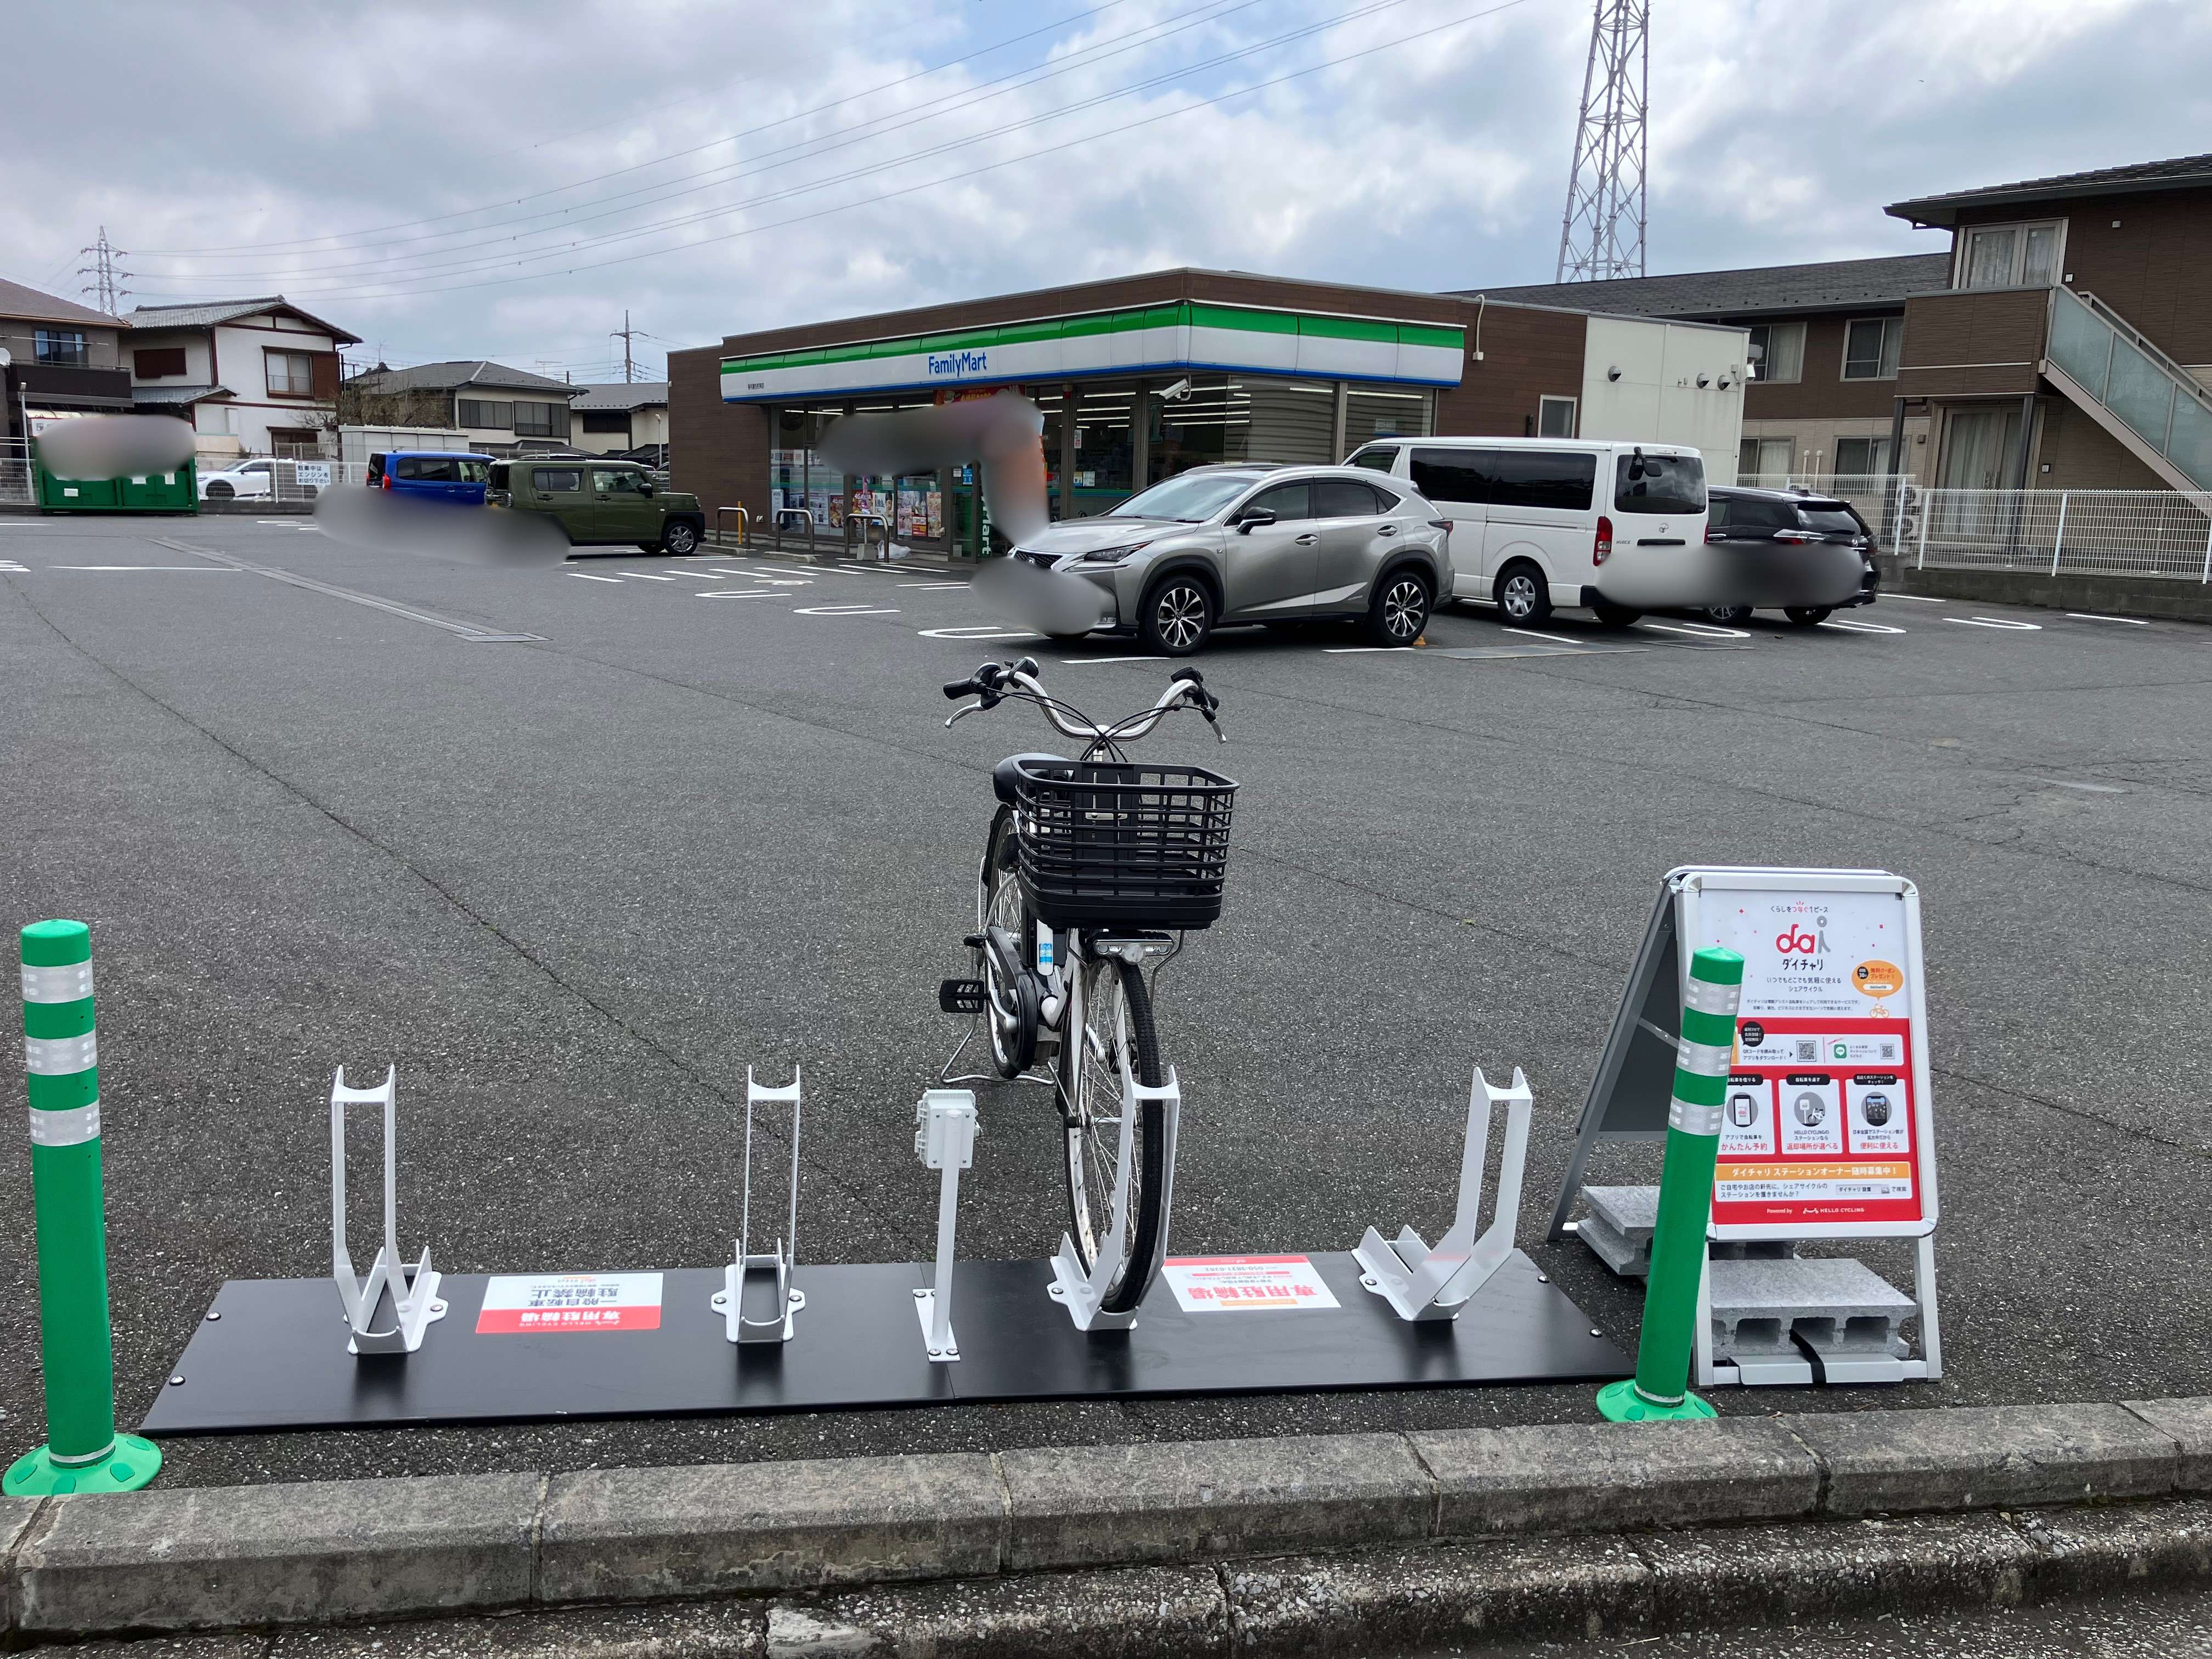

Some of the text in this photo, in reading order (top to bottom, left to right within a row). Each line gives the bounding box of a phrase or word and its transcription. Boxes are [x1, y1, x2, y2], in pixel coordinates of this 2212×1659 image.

[929, 352, 987, 377] FamilyMart
[1776, 916, 1831, 954] dai
[1782, 958, 1823, 970] ダイチャリ
[1721, 1142, 1768, 1150] かんたん予約
[1786, 1142, 1838, 1150] 返却場所が選べる
[1860, 1142, 1899, 1150] 便利に使える
[1732, 1168, 1771, 1177] ダイチャリ
[531, 1288, 618, 1298] 駐輪禁止
[1187, 1284, 1318, 1300] 専用駐輪場
[528, 1298, 617, 1307] 一般自転車
[520, 1310, 621, 1322] 専用駐輪場
